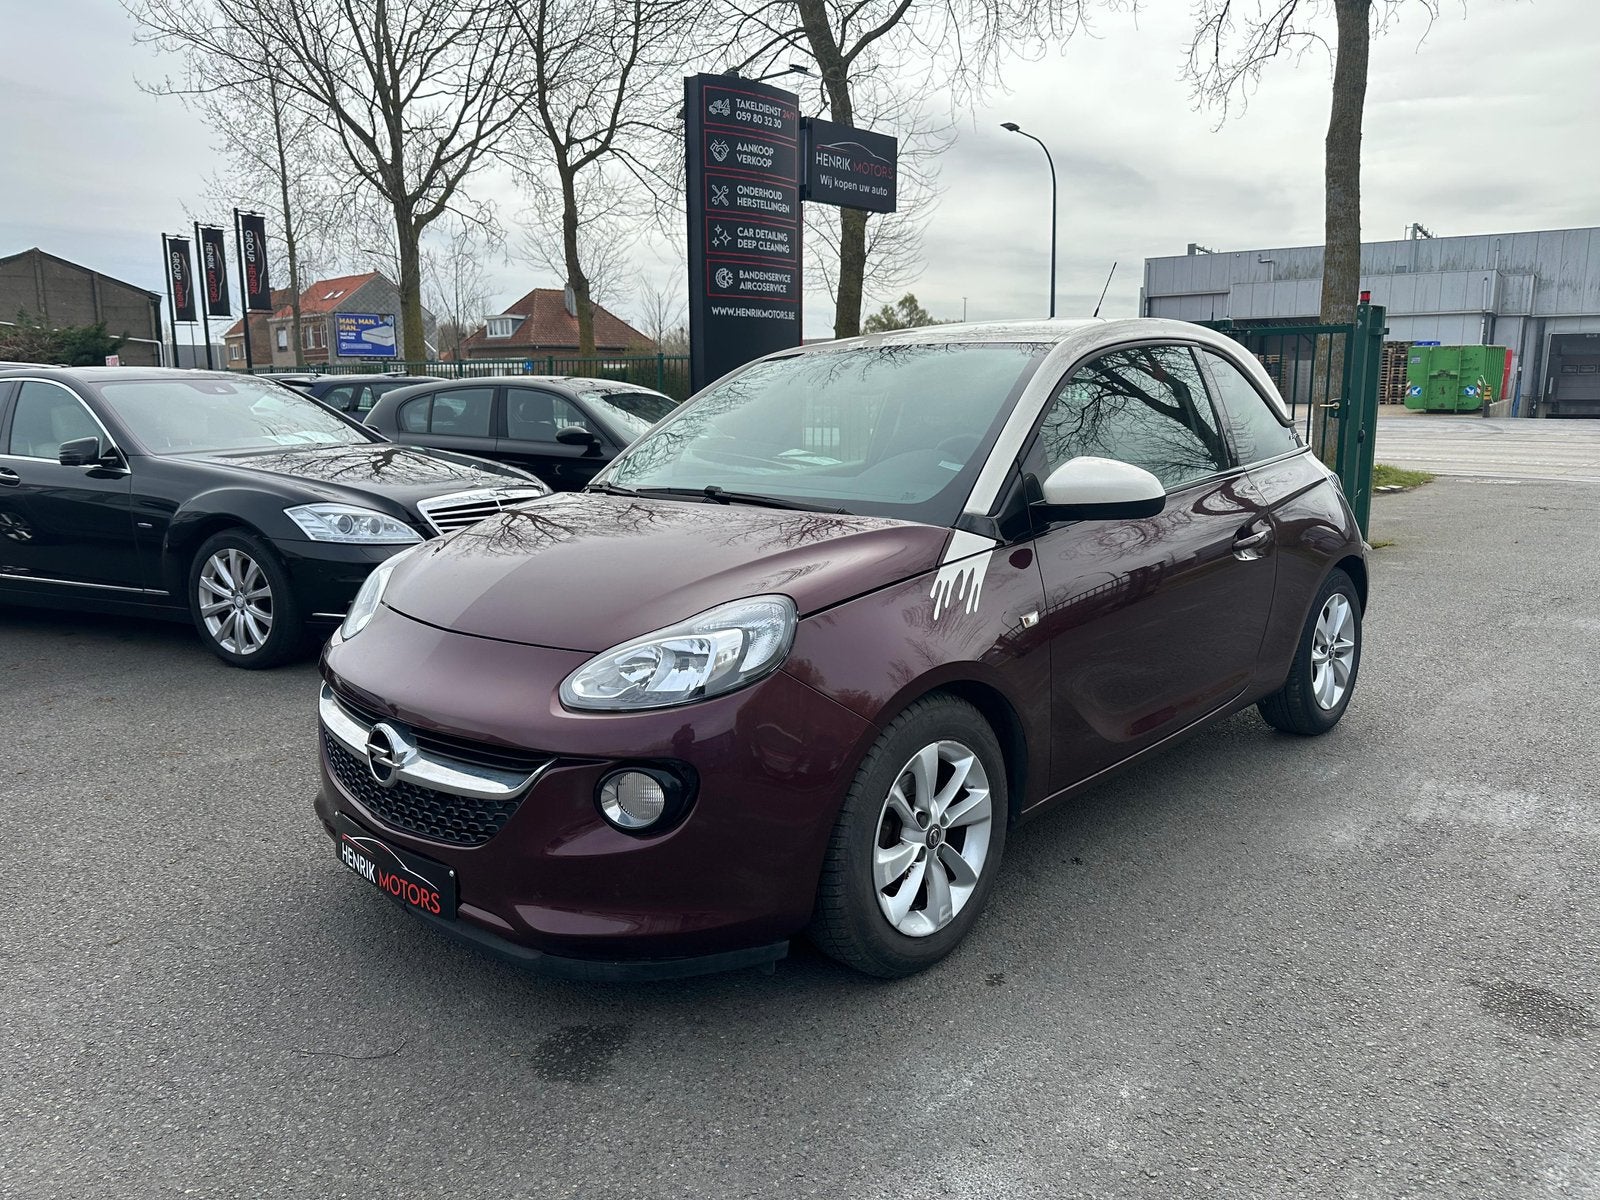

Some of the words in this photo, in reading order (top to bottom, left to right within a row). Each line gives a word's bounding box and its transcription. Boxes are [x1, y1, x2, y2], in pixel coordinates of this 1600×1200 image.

[736, 98, 781, 117] TAKELDIENST
[736, 111, 751, 121] 059
[753, 114, 762, 123] 80
[764, 116, 772, 126] 32
[774, 119, 782, 128] 30
[736, 142, 774, 156] AANKOOP
[736, 154, 772, 167] VERKOOP
[816, 152, 850, 171] HENRIK
[853, 162, 893, 179] MOTORS
[737, 185, 782, 200] ONDERHOUD
[820, 174, 832, 188] Wij
[835, 177, 857, 190] kopen
[860, 184, 870, 192] uw
[872, 186, 888, 196] auto
[737, 197, 790, 213] HERSTELLINGEN
[737, 227, 754, 237] CAR
[756, 229, 788, 242] DETAILING
[245, 230, 255, 262] GROUP
[738, 239, 757, 248] DEEP
[758, 241, 790, 253] CLEANING
[205, 242, 215, 269] HENRIK
[172, 252, 182, 280] GROUP
[248, 264, 257, 294] HENRIK
[739, 270, 791, 283] BANDENSERVICE
[208, 271, 217, 303] MOTORS
[739, 282, 787, 293] AIRCOSERVICE
[712, 307, 795, 320] WWW.HENRIKMOTORS.BE
[341, 842, 376, 883] HENRIK
[379, 868, 440, 914] MOTORS
